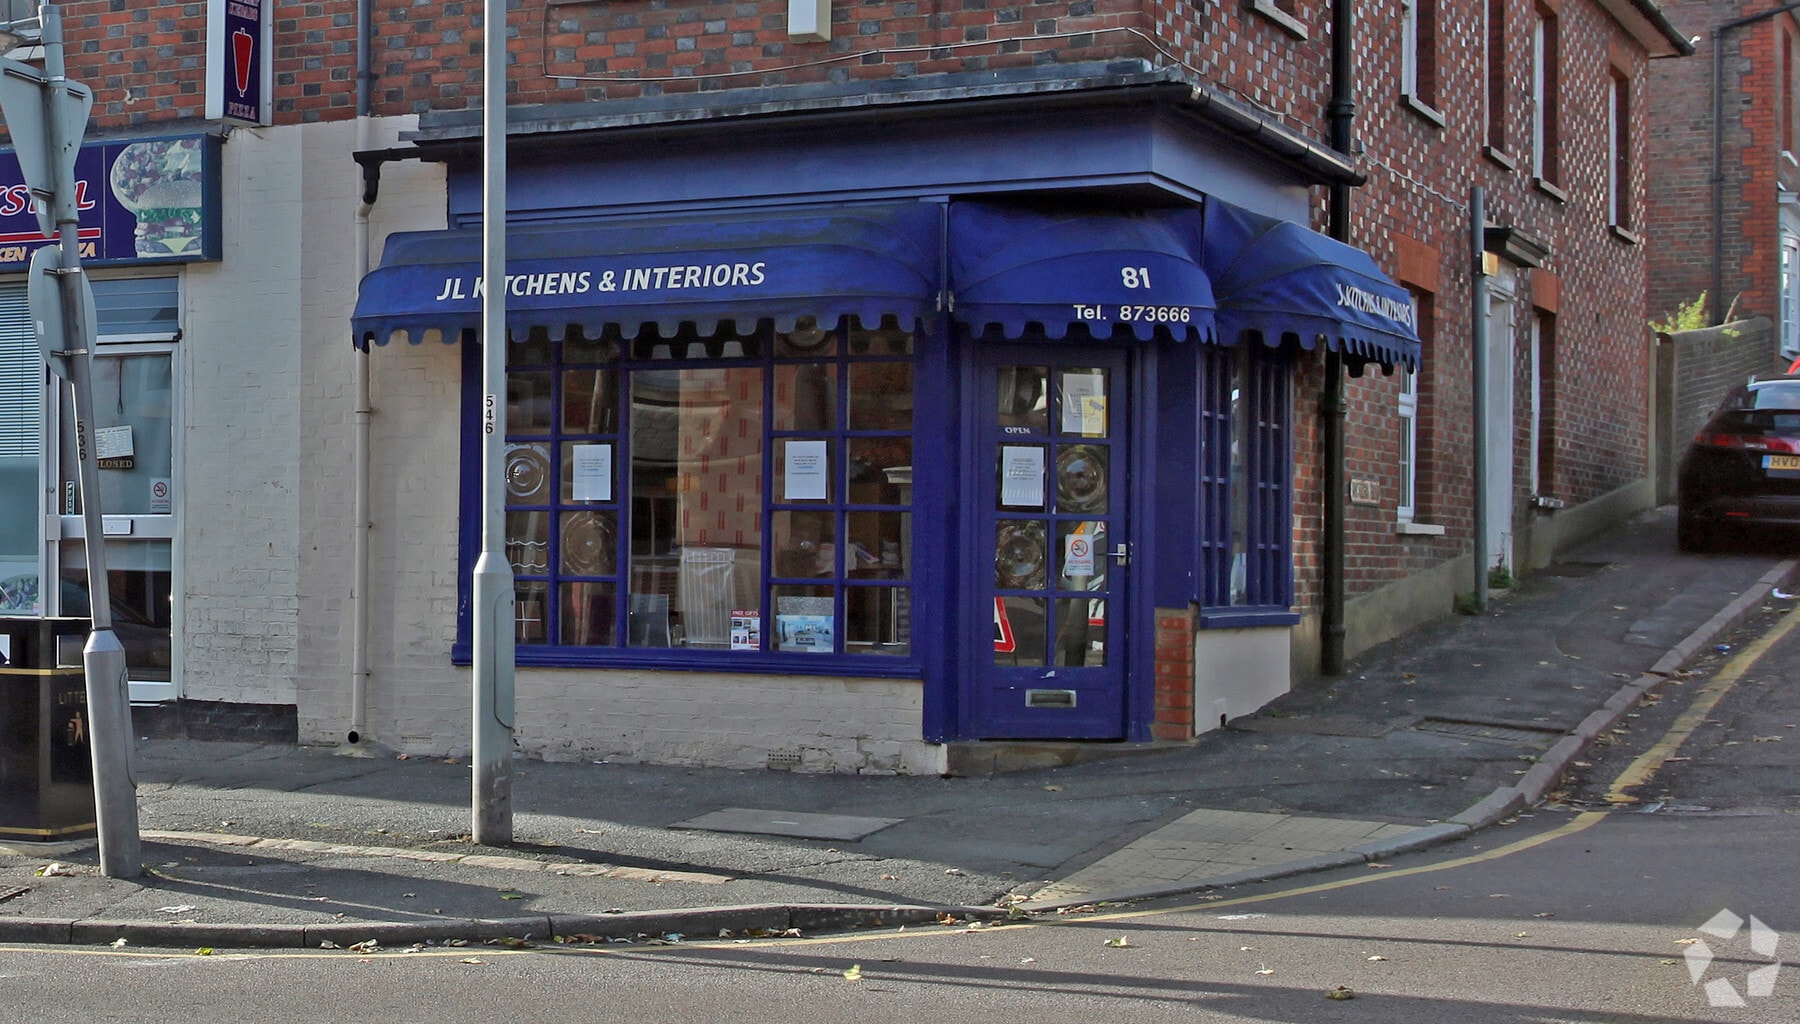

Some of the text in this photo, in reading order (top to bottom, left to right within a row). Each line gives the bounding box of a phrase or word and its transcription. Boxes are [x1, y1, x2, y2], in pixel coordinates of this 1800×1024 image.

[228, 101, 256, 119] PIZZA
[436, 262, 766, 301] JL KTCHENS & INTERIORS
[1121, 266, 1151, 289] 81
[1073, 304, 1190, 323] Tel. 873666
[485, 395, 493, 434] 546
[1004, 426, 1031, 434] OPEN
[96, 459, 133, 469] LOSED
[59, 690, 86, 705] LITTE
